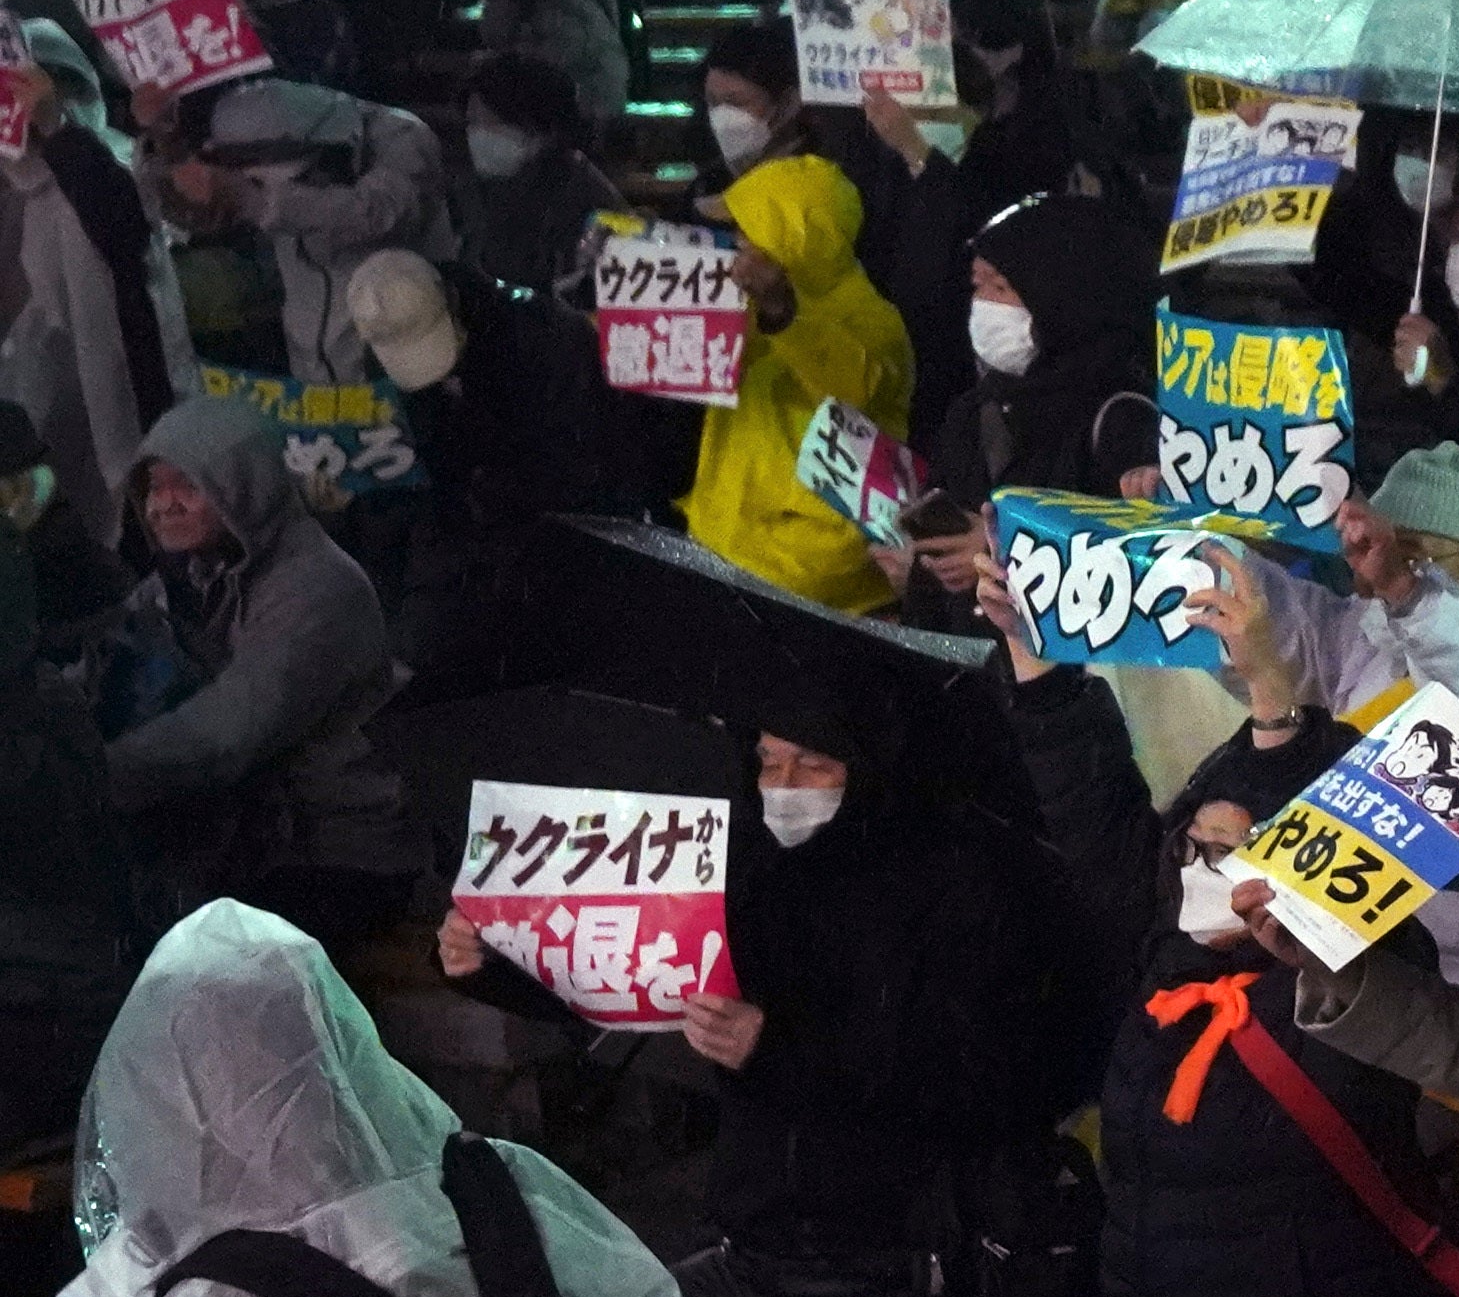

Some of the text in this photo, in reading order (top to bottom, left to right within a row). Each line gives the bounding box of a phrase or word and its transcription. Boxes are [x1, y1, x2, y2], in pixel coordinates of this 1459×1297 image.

[605, 314, 744, 389] 撤退を!
[1158, 415, 1349, 528] やめろ
[1006, 526, 1217, 649] やめろ
[469, 808, 723, 890] ウクライナから
[1250, 810, 1414, 925] やめろ!
